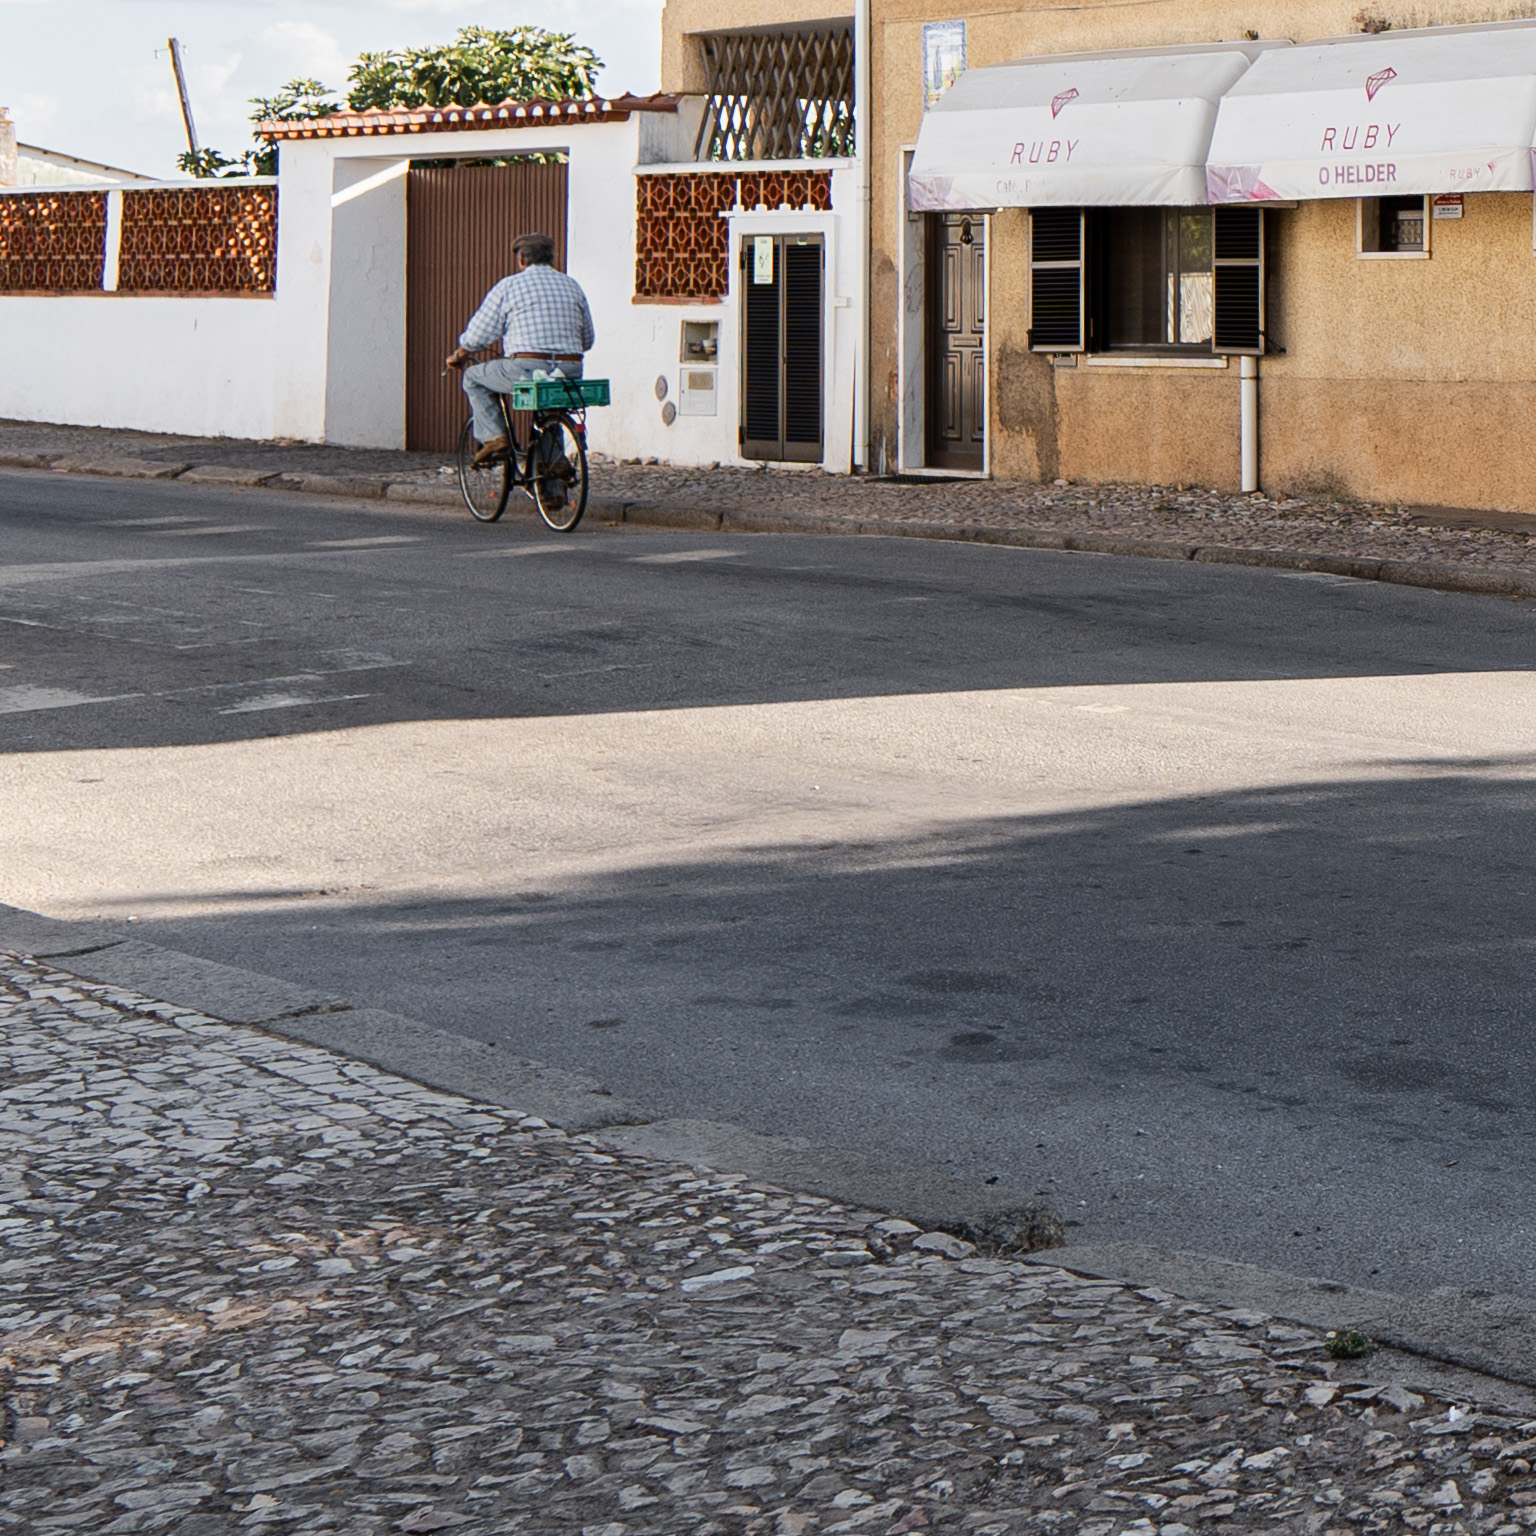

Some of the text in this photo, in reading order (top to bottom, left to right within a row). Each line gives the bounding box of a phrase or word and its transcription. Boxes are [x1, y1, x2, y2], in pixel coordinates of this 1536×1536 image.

[1320, 123, 1401, 151] RUBY
[1010, 139, 1080, 164] RUBY
[1318, 163, 1397, 185] O HELDER
[1450, 167, 1481, 180] RUBY
